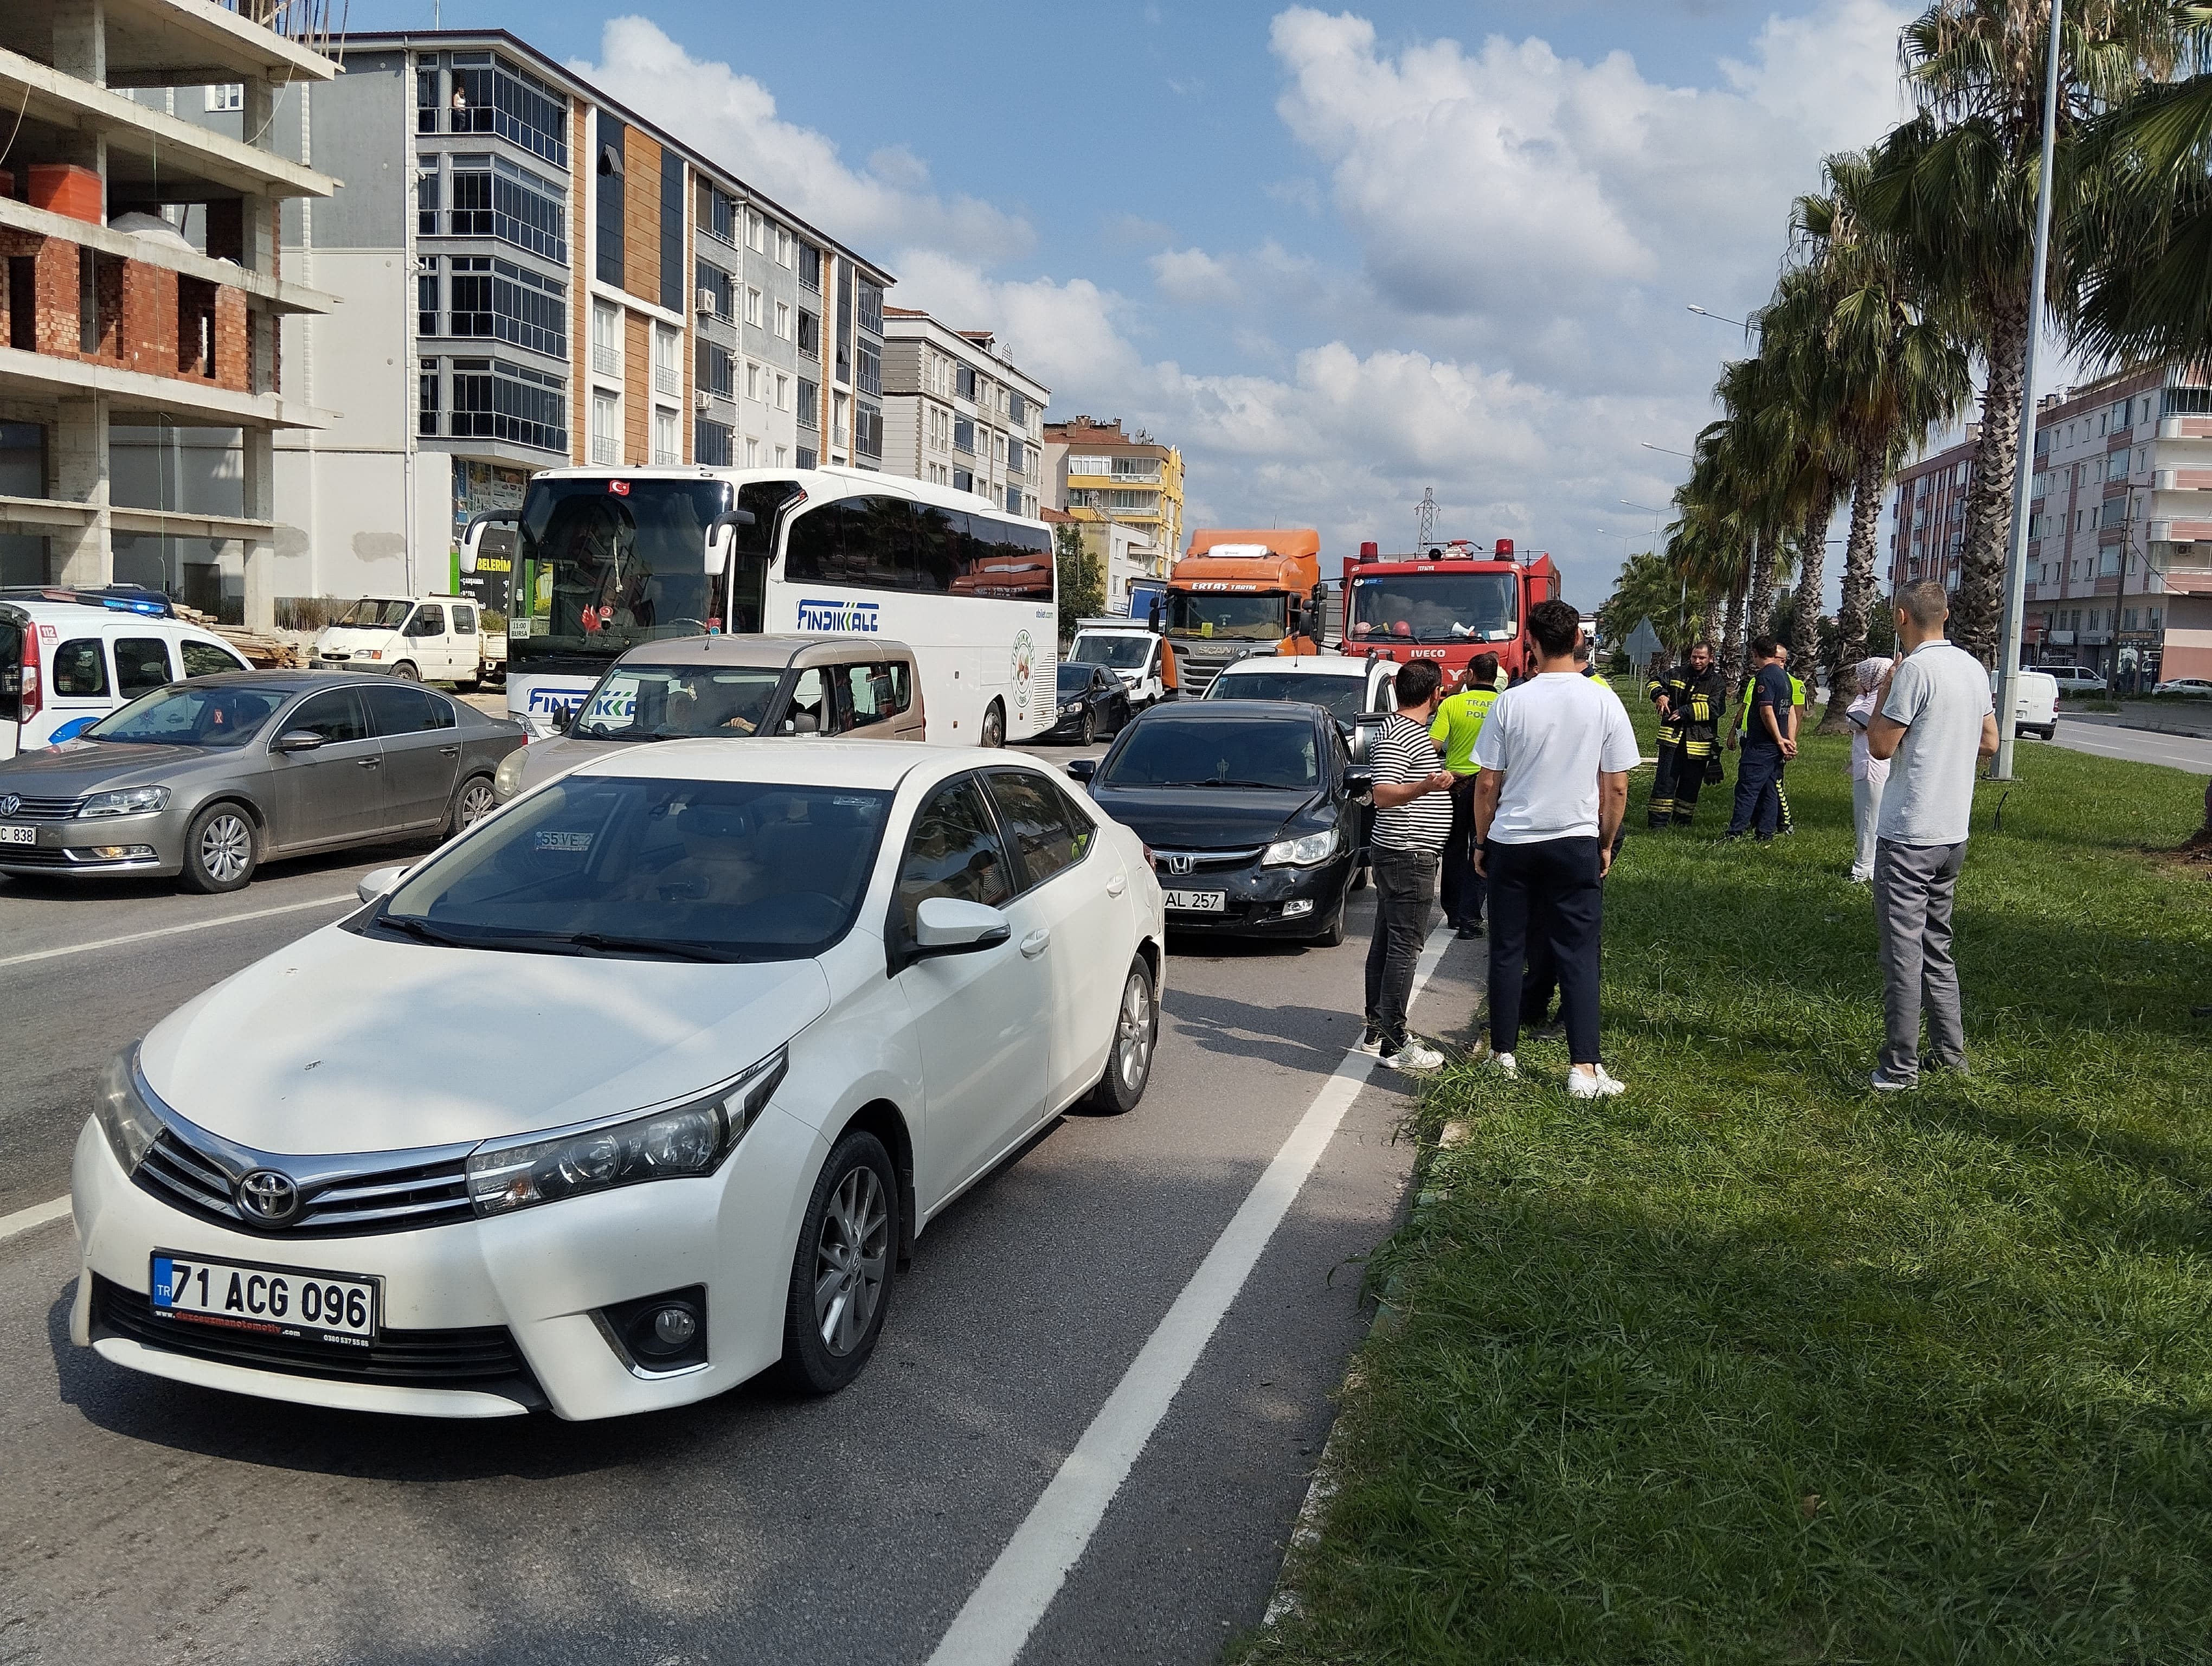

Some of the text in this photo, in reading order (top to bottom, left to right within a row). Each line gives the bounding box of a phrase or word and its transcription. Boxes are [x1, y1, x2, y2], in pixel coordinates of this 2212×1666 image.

[477, 556, 511, 572] BELERİM
[41, 626, 56, 637] 112
[1198, 646, 1243, 655] SCANIA
[1411, 649, 1446, 658] IVECO
[1466, 699, 1492, 708] TRAF
[1466, 710, 1487, 719] POL
[0, 828, 33, 842] C 838
[542, 832, 558, 845] 55
[562, 833, 580, 847] VE
[1165, 892, 1219, 909] AL 257
[157, 1284, 171, 1297] TR
[171, 1264, 368, 1329] 71 ACG 096
[323, 1335, 340, 1343] 0380
[340, 1337, 352, 1345] 537
